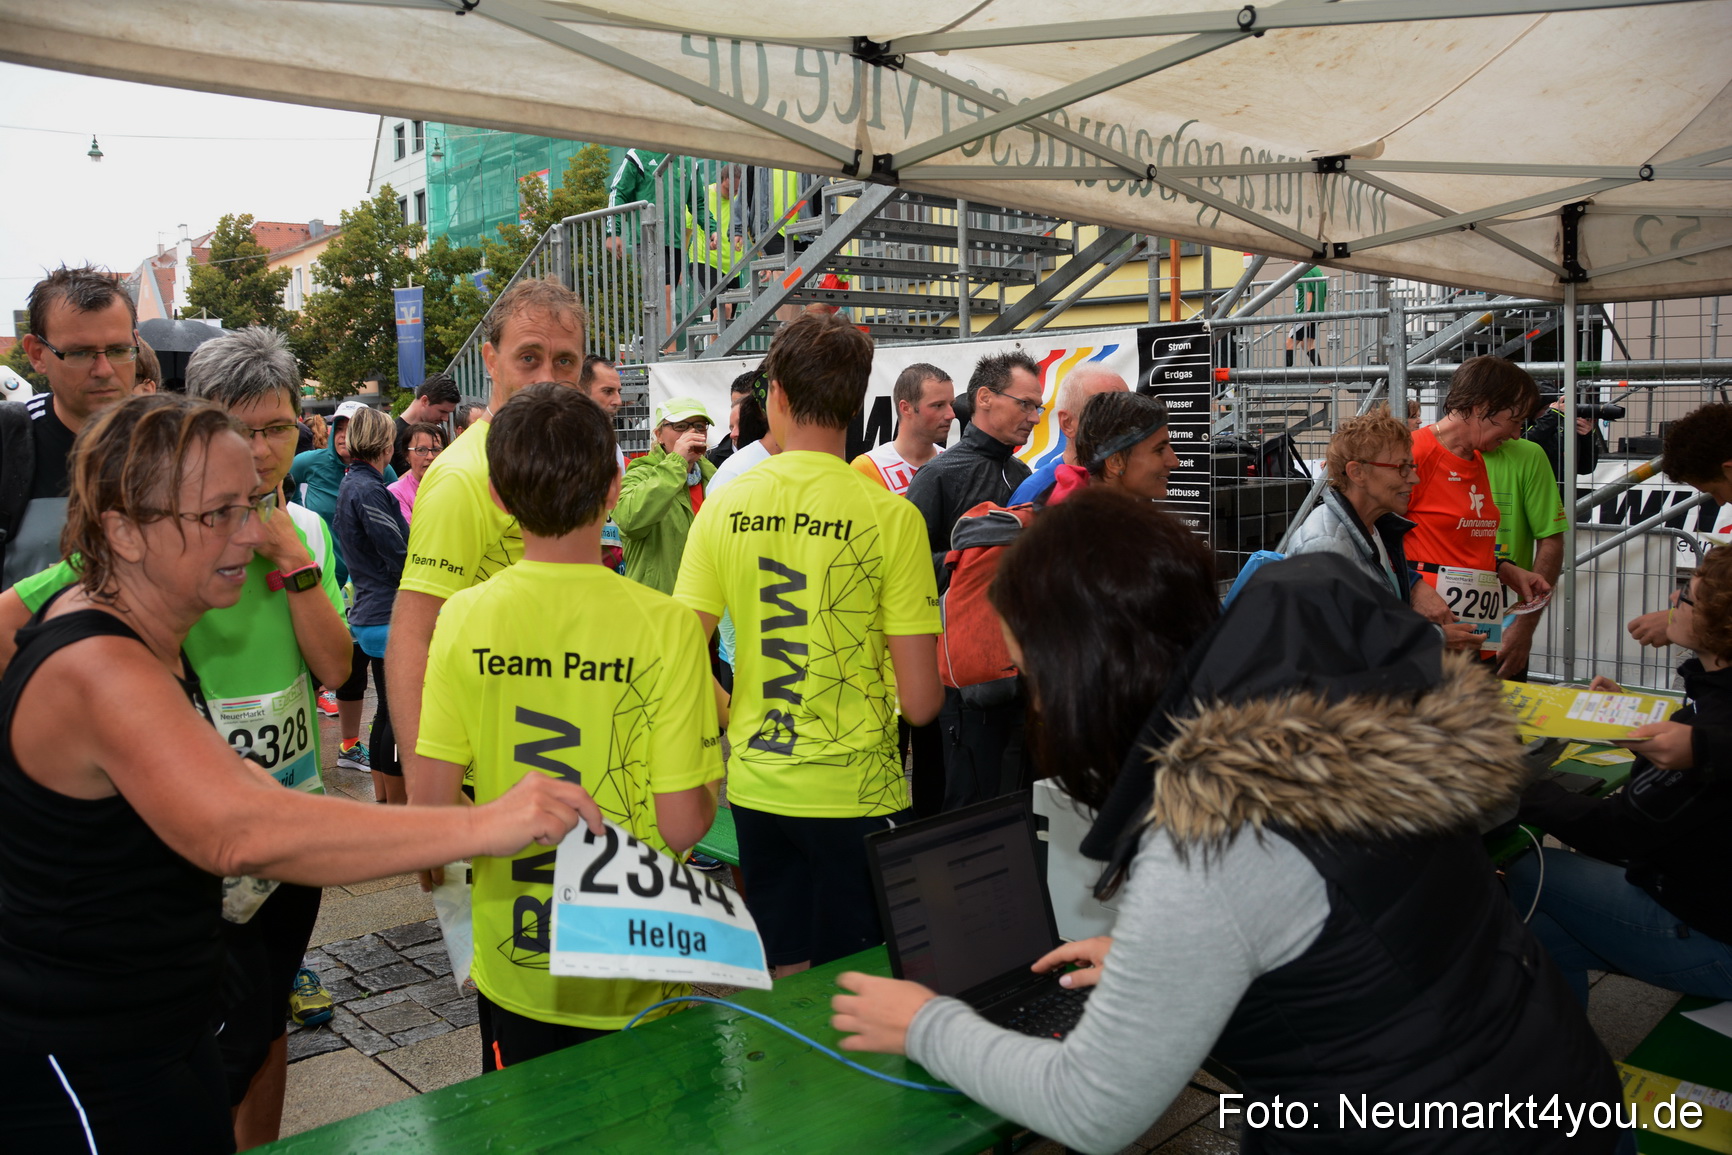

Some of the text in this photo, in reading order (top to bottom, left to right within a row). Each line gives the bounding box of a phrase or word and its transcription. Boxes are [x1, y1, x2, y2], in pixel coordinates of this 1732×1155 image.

[1168, 342, 1191, 352] Strom
[1164, 370, 1193, 380] Erdgas
[1166, 400, 1193, 409] Wasser
[1179, 458, 1194, 467] zeit
[1165, 488, 1200, 498] adtbusse
[730, 511, 852, 541] Team Partl
[1456, 517, 1497, 530] funrunners
[412, 553, 437, 567] Team
[925, 596, 940, 607] Tea
[1446, 586, 1500, 620] 2290
[747, 557, 808, 757] BMW
[472, 648, 635, 684] Team Partl
[220, 709, 265, 721] NeuerMarkt
[579, 825, 737, 918] 2344
[627, 918, 708, 957] Helga
